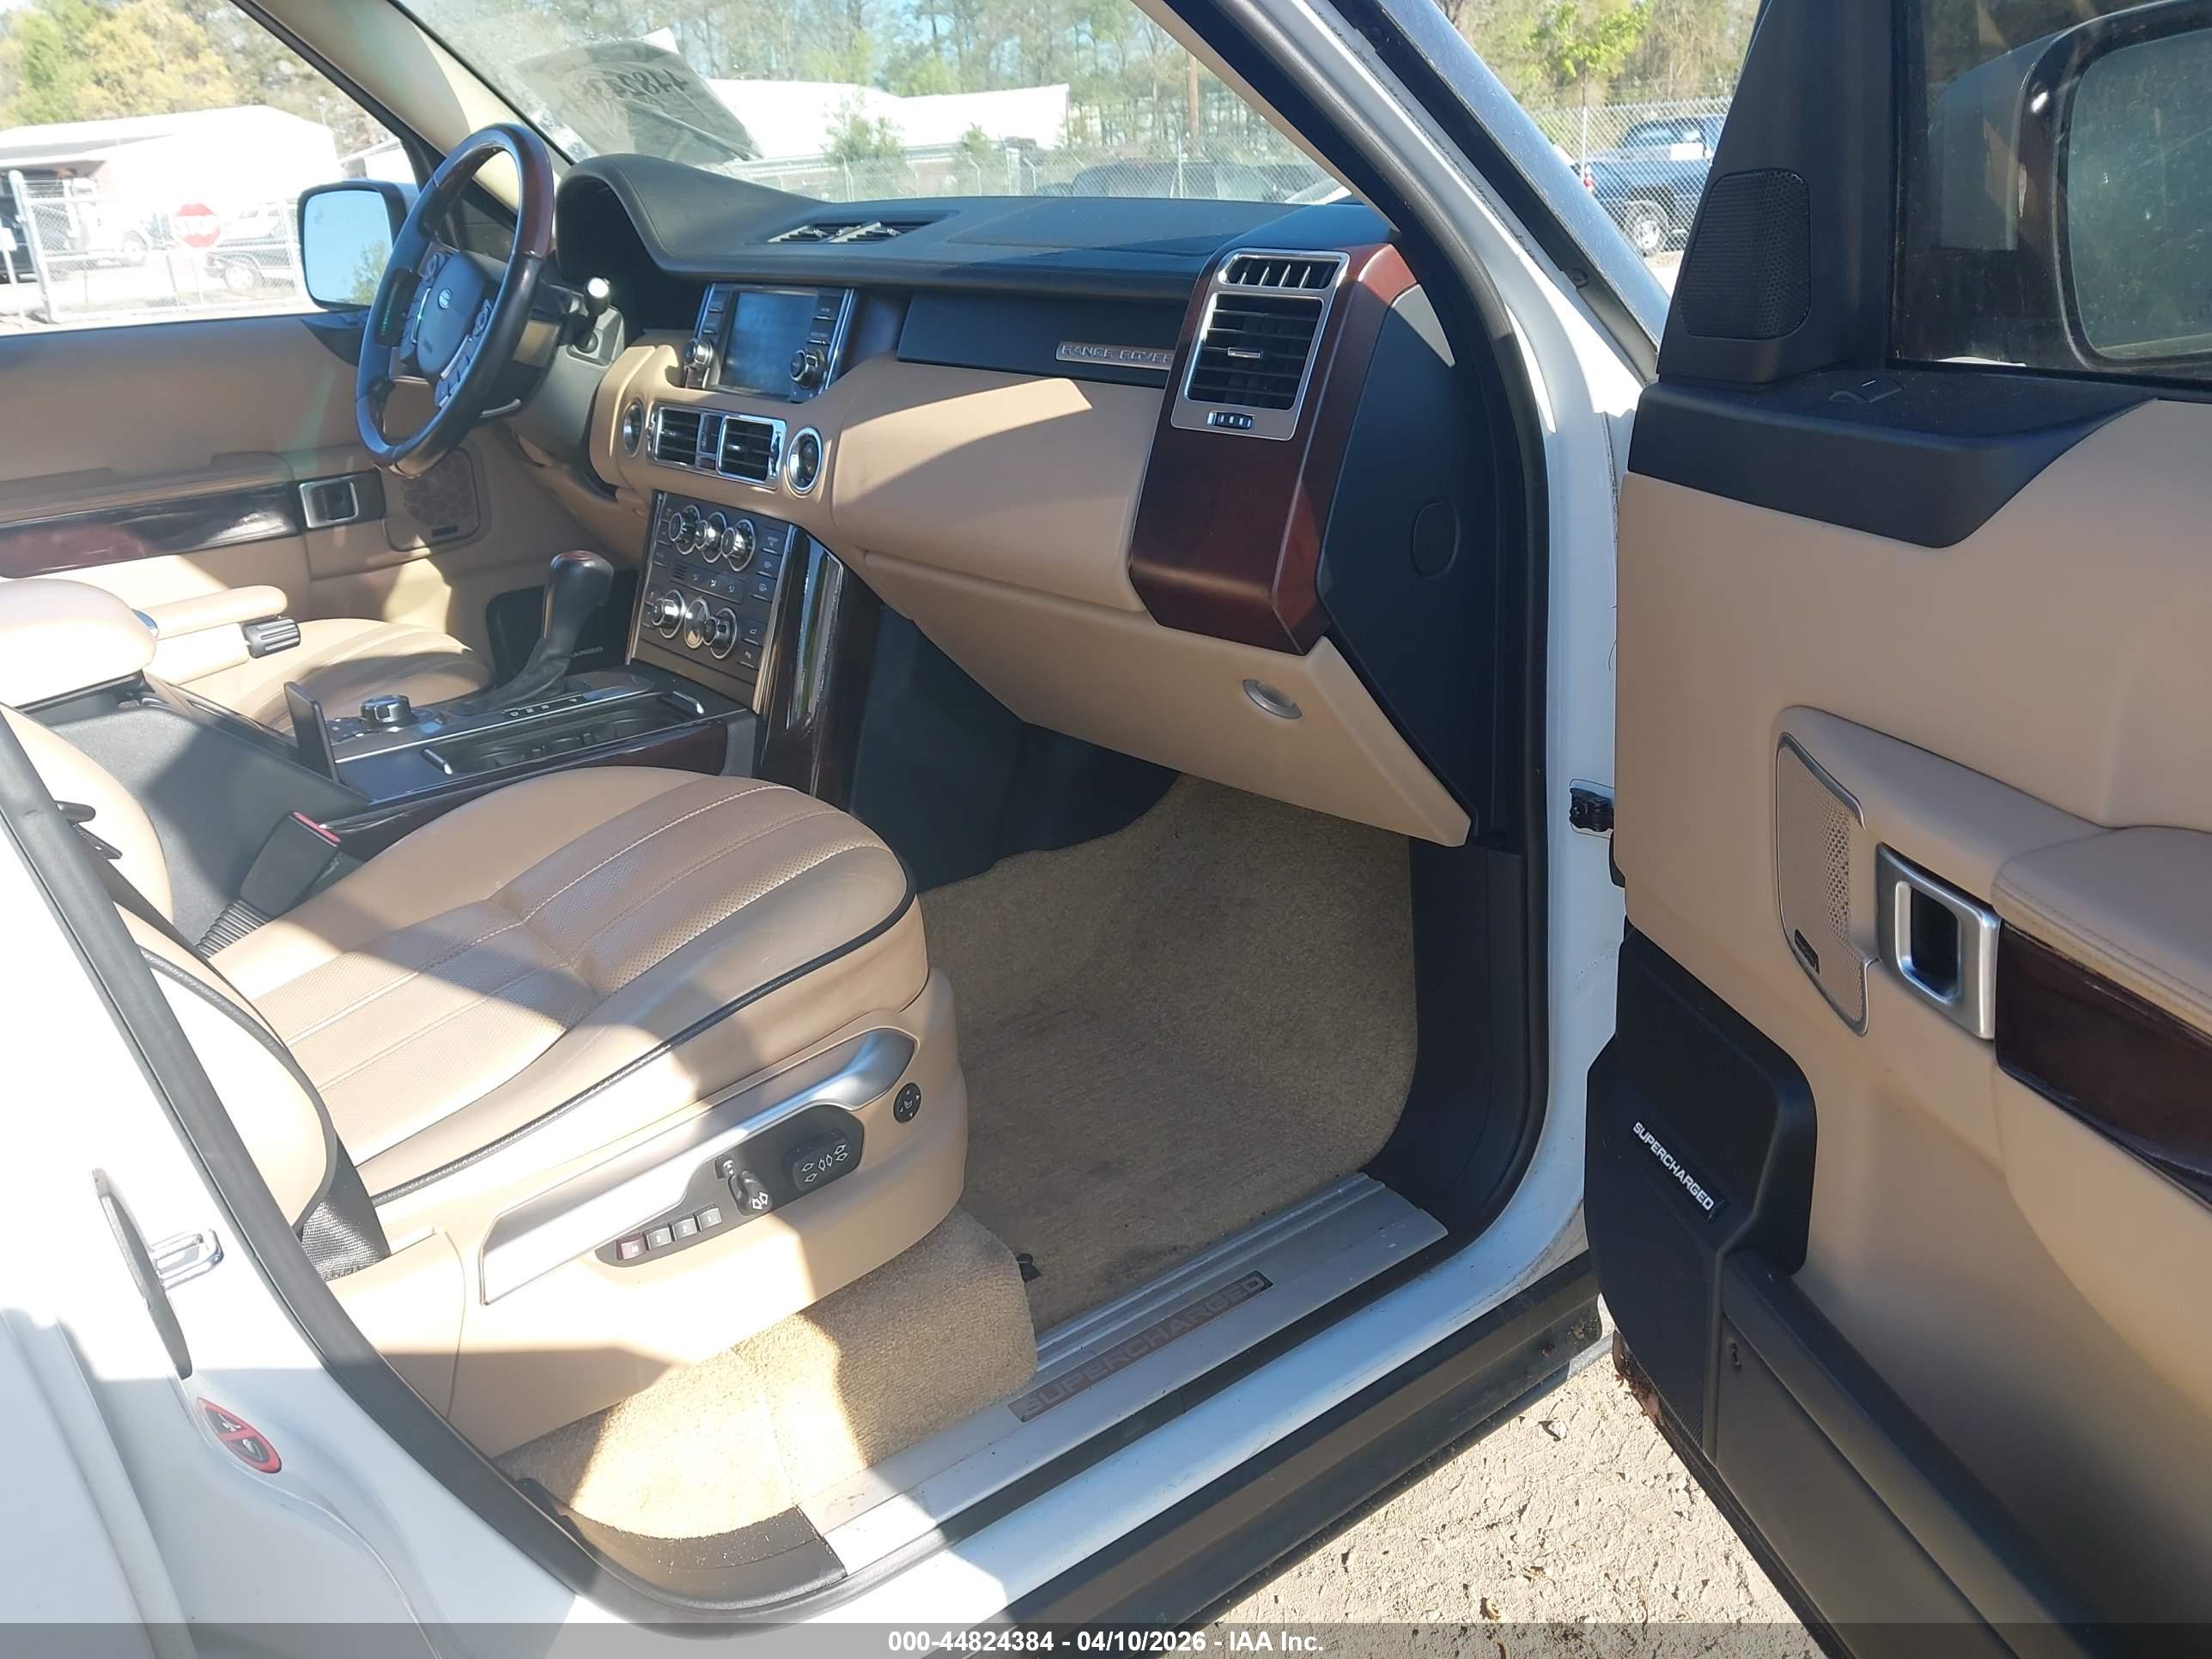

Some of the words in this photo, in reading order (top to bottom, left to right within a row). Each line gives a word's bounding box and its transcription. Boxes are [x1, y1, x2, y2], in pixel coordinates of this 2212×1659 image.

[1060, 344, 1114, 359] RANGE
[1632, 1121, 1715, 1211] SUPERCHARGED
[1020, 1275, 1266, 1417] SUPERCHARGED
